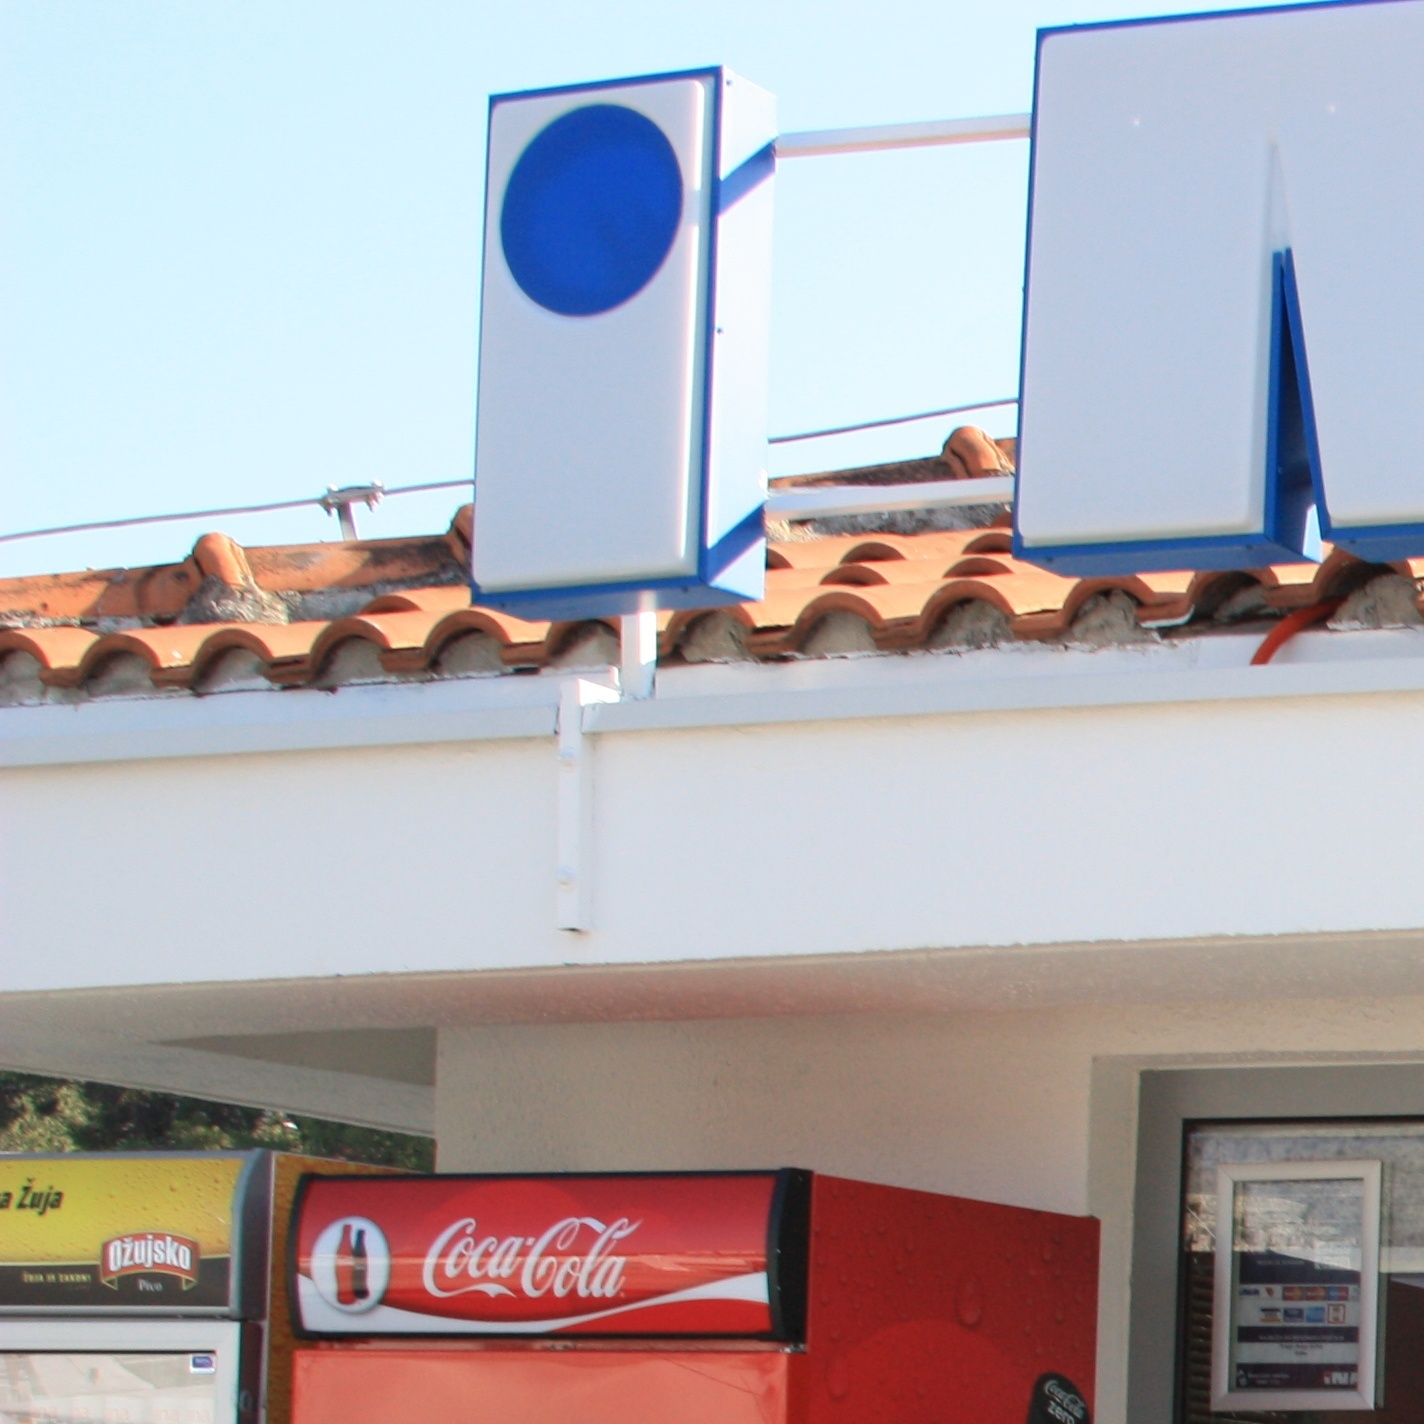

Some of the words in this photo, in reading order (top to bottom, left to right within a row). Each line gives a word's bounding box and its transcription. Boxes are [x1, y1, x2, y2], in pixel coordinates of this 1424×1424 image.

[17, 1177, 64, 1216] Žuja
[109, 1234, 192, 1272] Ožujsko
[422, 1216, 642, 1300] Coca-Cola
